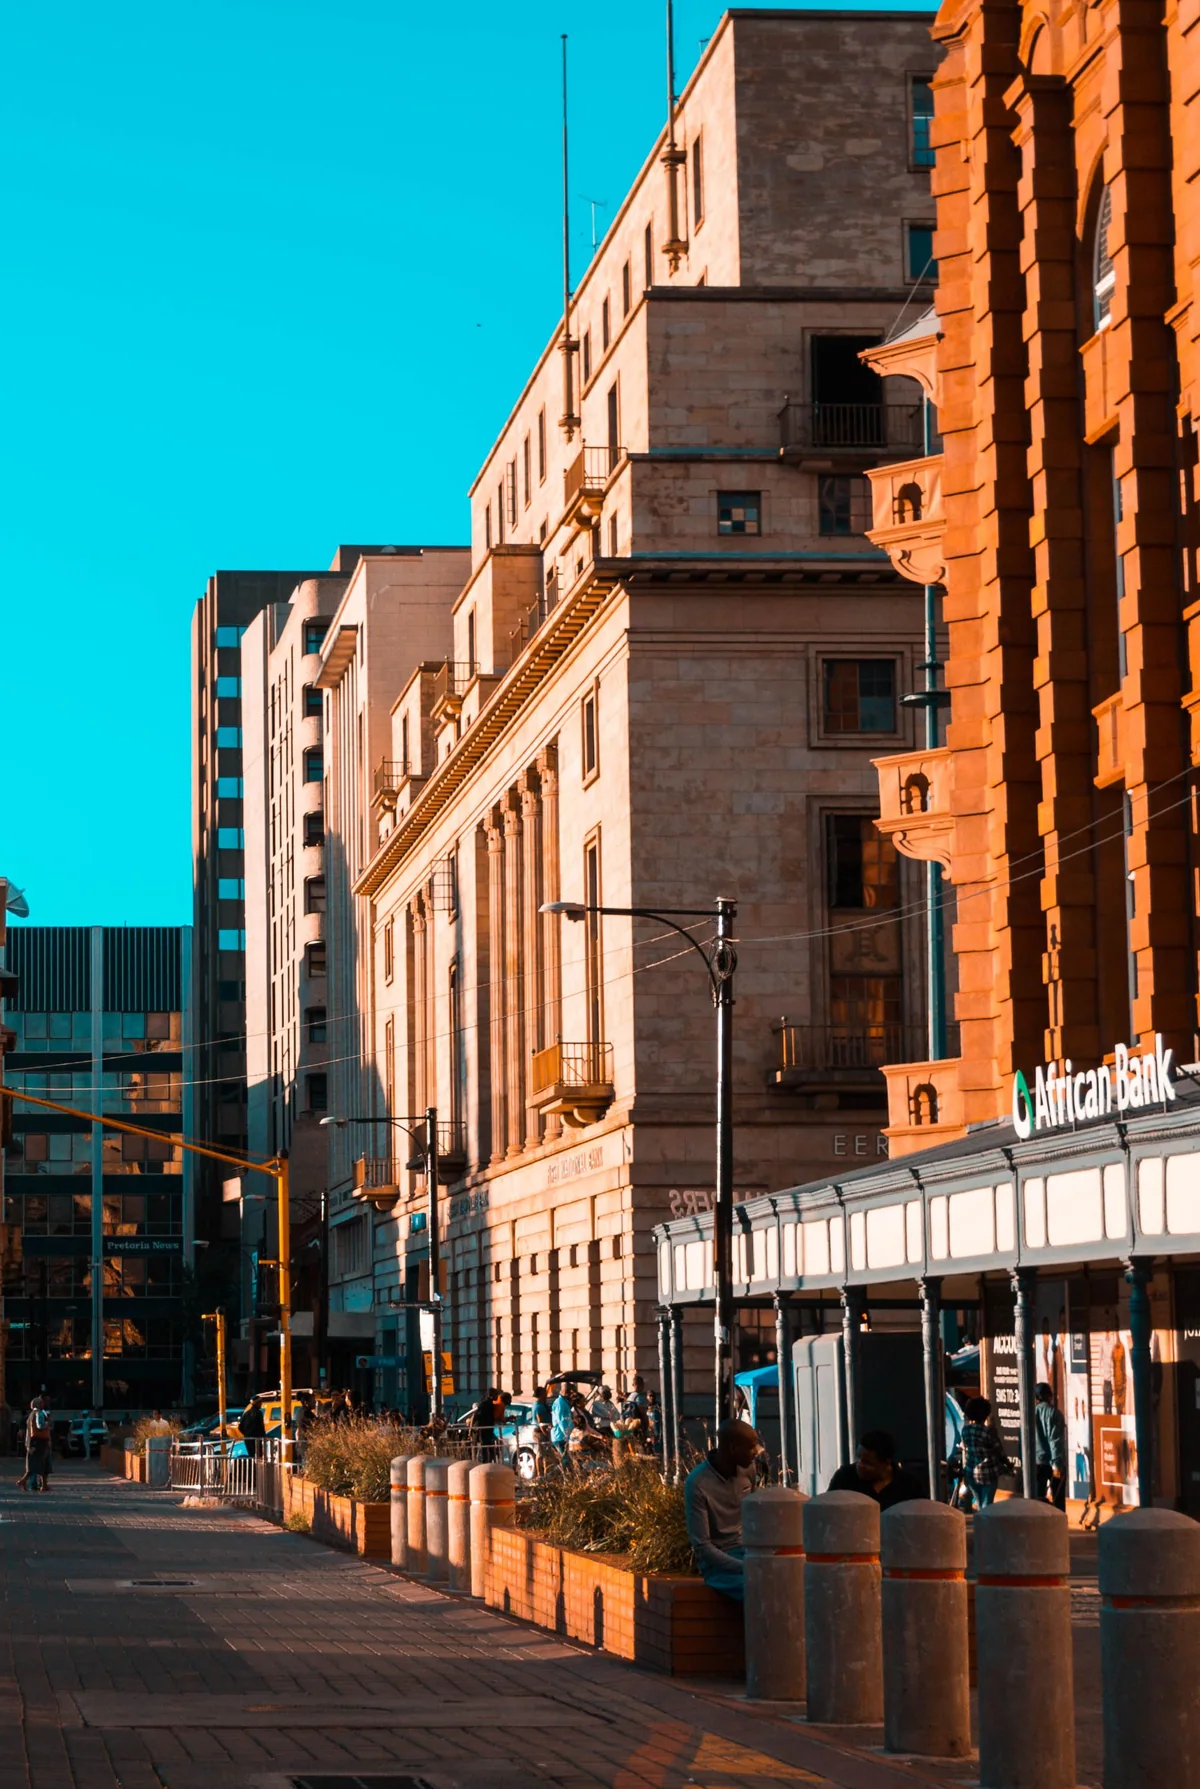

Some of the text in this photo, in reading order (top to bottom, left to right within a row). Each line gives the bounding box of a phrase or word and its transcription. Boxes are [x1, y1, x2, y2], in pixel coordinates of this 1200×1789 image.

[1035, 1032, 1176, 1130] African Bank
[107, 1241, 180, 1250] Pretoria News
